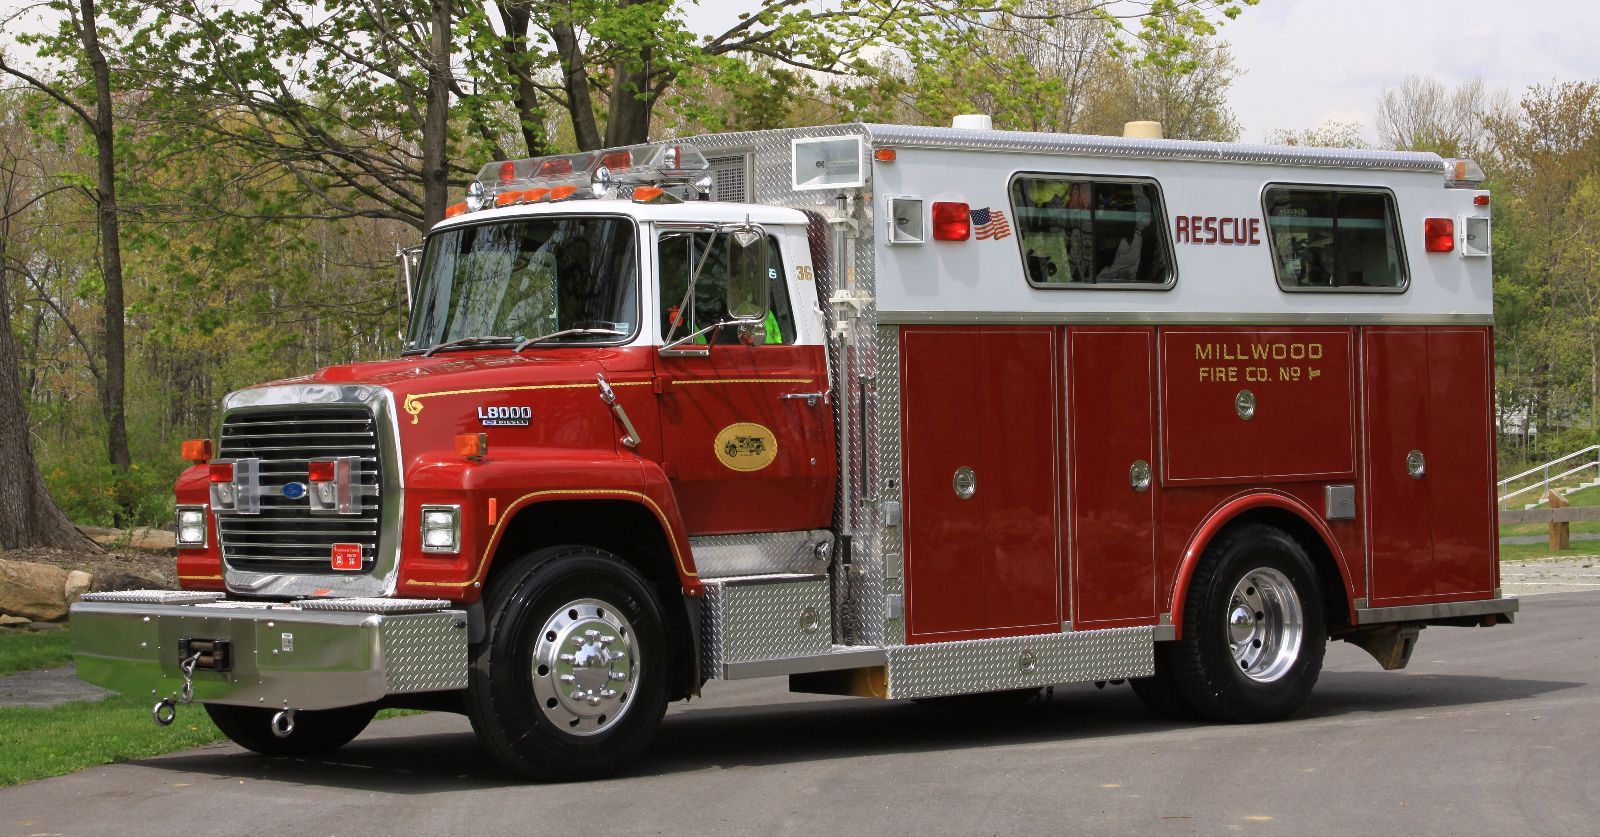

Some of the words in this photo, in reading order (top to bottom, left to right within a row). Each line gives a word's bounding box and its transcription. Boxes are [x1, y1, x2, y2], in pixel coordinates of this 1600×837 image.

[1175, 215, 1261, 246] RESCUE
[795, 265, 813, 281] 36
[1195, 343, 1323, 360] MILLWOOD
[1199, 366, 1238, 382] FIRE
[1245, 366, 1273, 382] CO.
[477, 406, 532, 419] L8000
